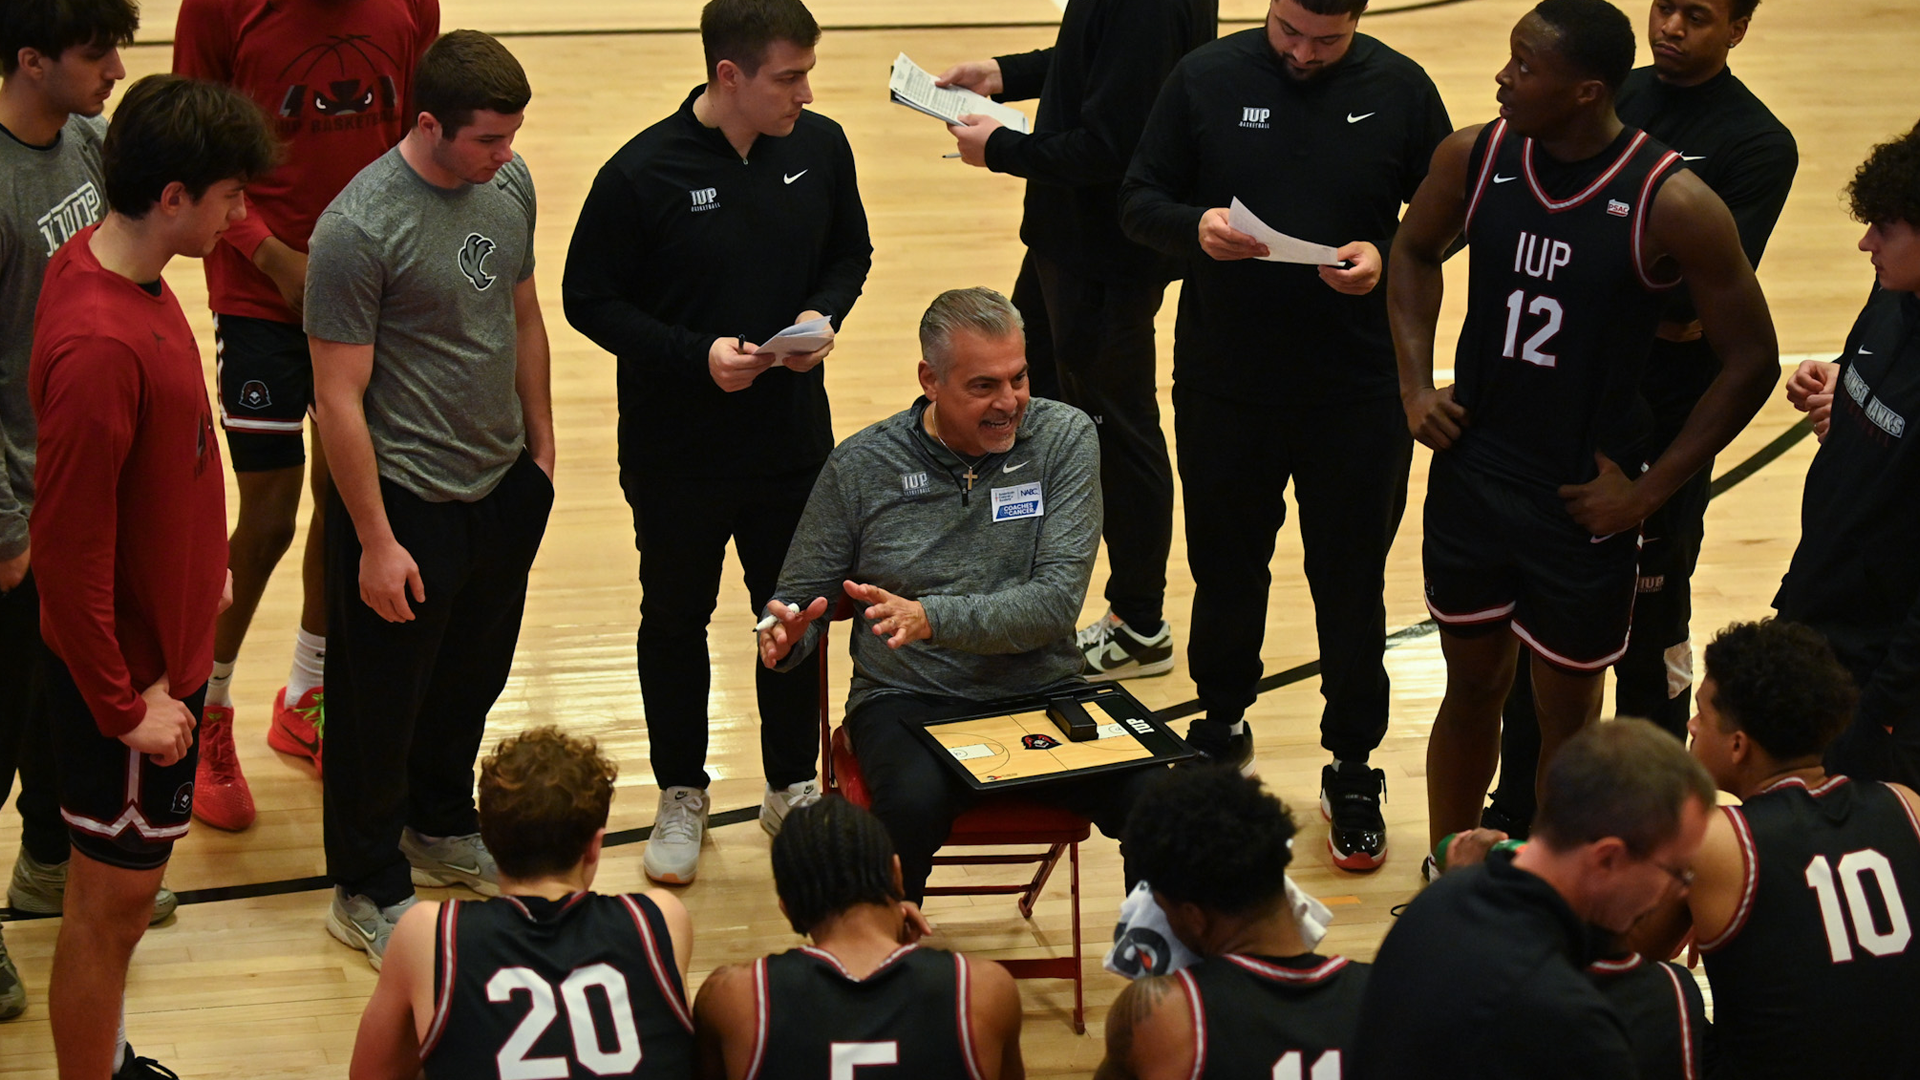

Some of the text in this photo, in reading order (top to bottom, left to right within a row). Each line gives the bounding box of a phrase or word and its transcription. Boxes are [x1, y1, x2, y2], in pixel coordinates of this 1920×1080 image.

[1242, 106, 1270, 123] IUP
[690, 187, 717, 205] IUP
[1514, 231, 1572, 281] IUP
[1502, 289, 1563, 367] 12
[901, 472, 928, 490] IUP
[1003, 501, 1034, 512] COACHES
[1125, 717, 1156, 735] IUP
[1804, 847, 1912, 964] 10
[485, 962, 643, 1080] 20
